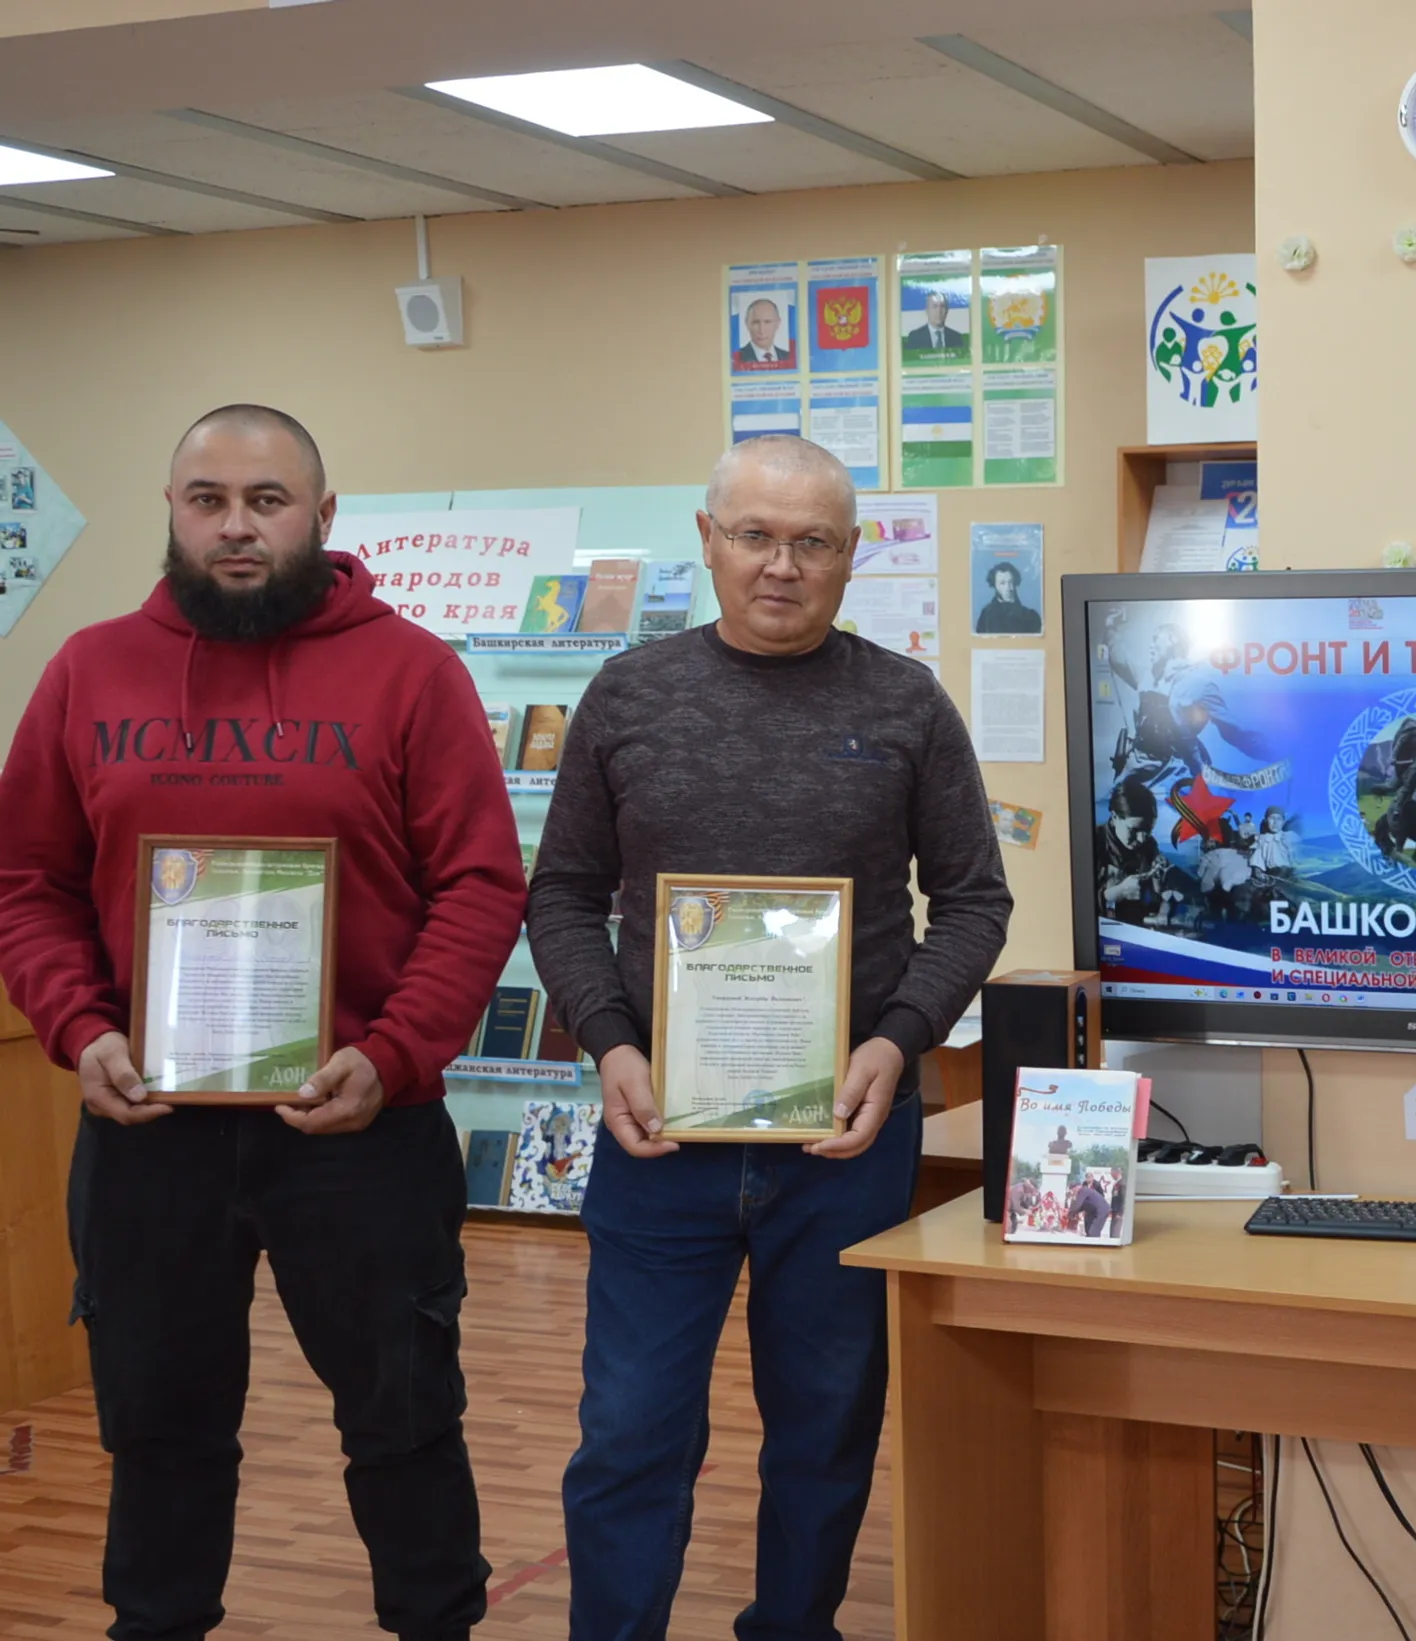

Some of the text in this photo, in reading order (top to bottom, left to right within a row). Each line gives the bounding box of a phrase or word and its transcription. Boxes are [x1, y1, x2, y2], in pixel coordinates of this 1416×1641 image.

[356, 534, 531, 560] Литература
[374, 572, 501, 591] народов
[397, 604, 518, 624] го края
[473, 637, 621, 650] Башкирская литература
[1209, 641, 1347, 675] ФРОНТ
[1362, 641, 1390, 675] И
[88, 718, 363, 770] MCMXCIX
[151, 774, 284, 786] ICONO COUTURE
[167, 918, 299, 930] БЛАГОДАРСТВЕННОЕ
[206, 929, 259, 939] ПИСЬМО
[1271, 947, 1282, 962] В
[1295, 946, 1377, 966] ВЕЛИКОЙ
[686, 963, 813, 974] БЛАГОДАРСТВЕННОЕ
[725, 973, 775, 983] ПИСЬМО
[1271, 969, 1284, 985] И
[506, 1067, 573, 1079] литература
[1020, 1098, 1131, 1113] Во имя Победы
